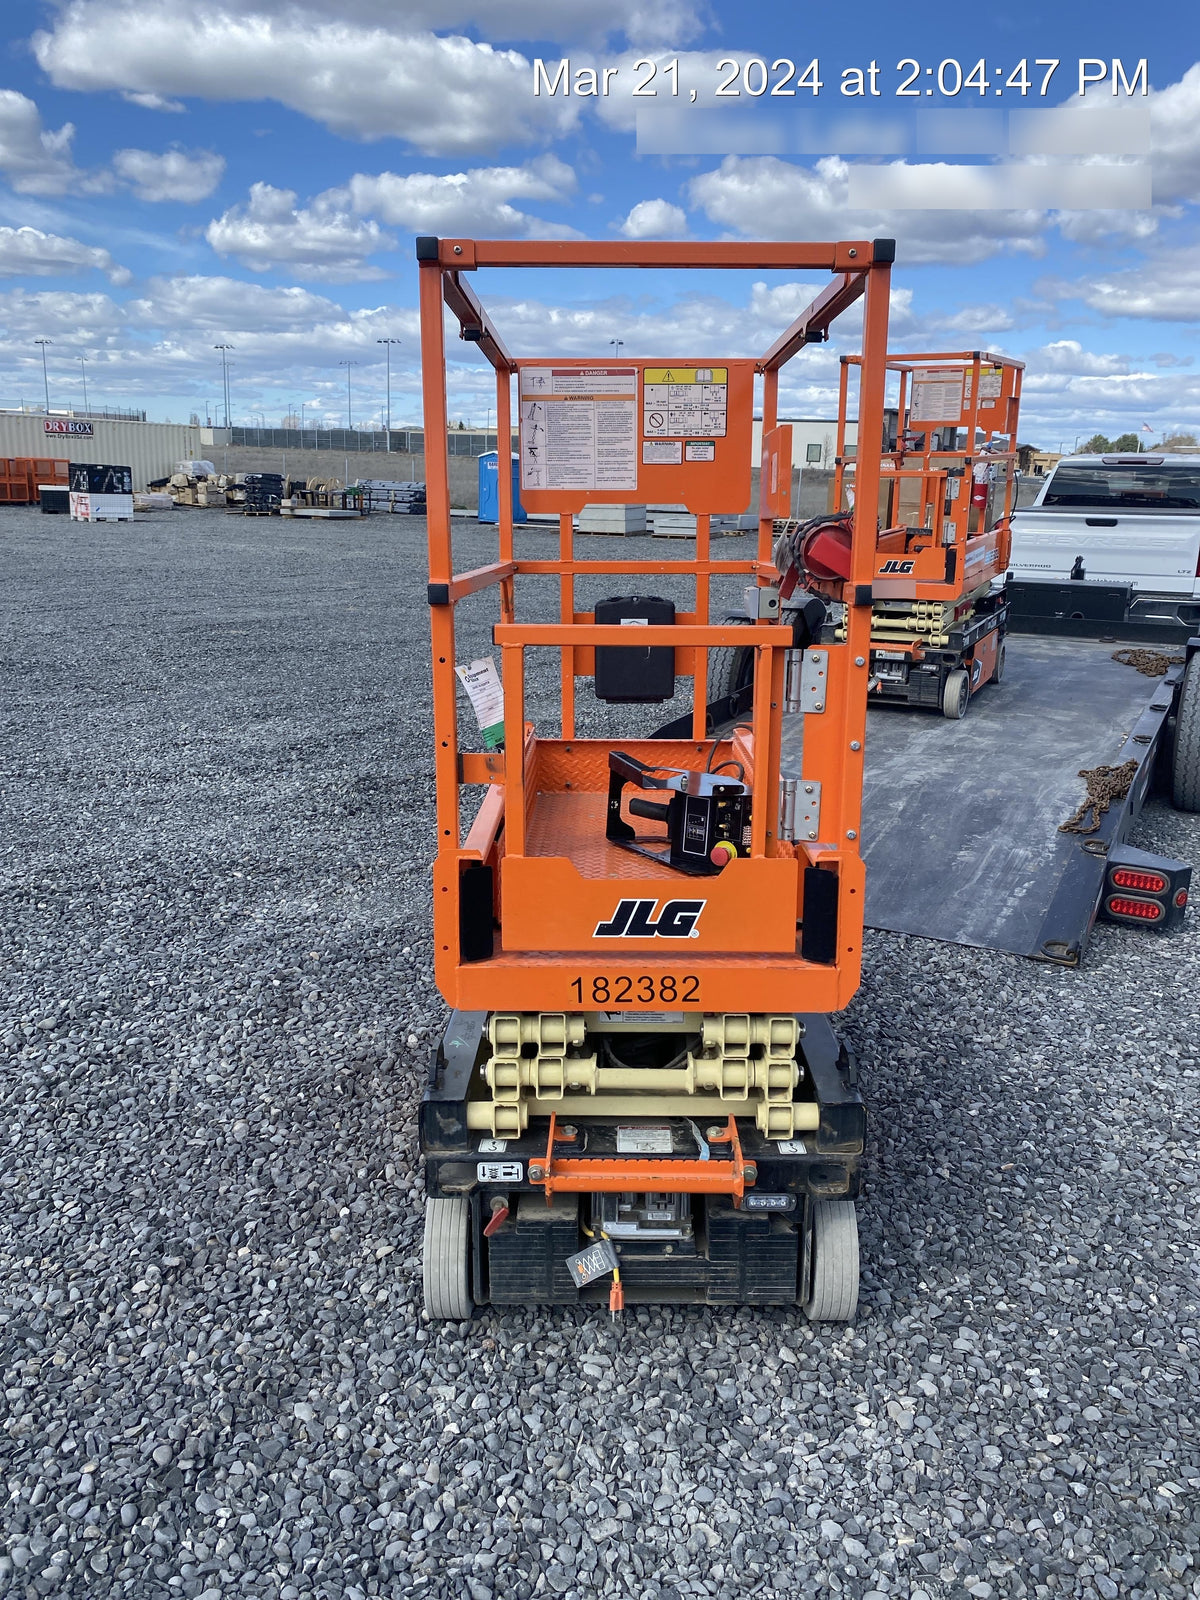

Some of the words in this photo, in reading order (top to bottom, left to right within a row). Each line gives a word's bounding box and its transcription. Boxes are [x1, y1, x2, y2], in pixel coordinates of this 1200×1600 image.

[44, 421, 91, 433] DRYBOX
[1017, 533, 1186, 550] CHEVROLET
[878, 559, 915, 574] JLG
[592, 898, 706, 938] JLG
[570, 975, 700, 1003] 182382
